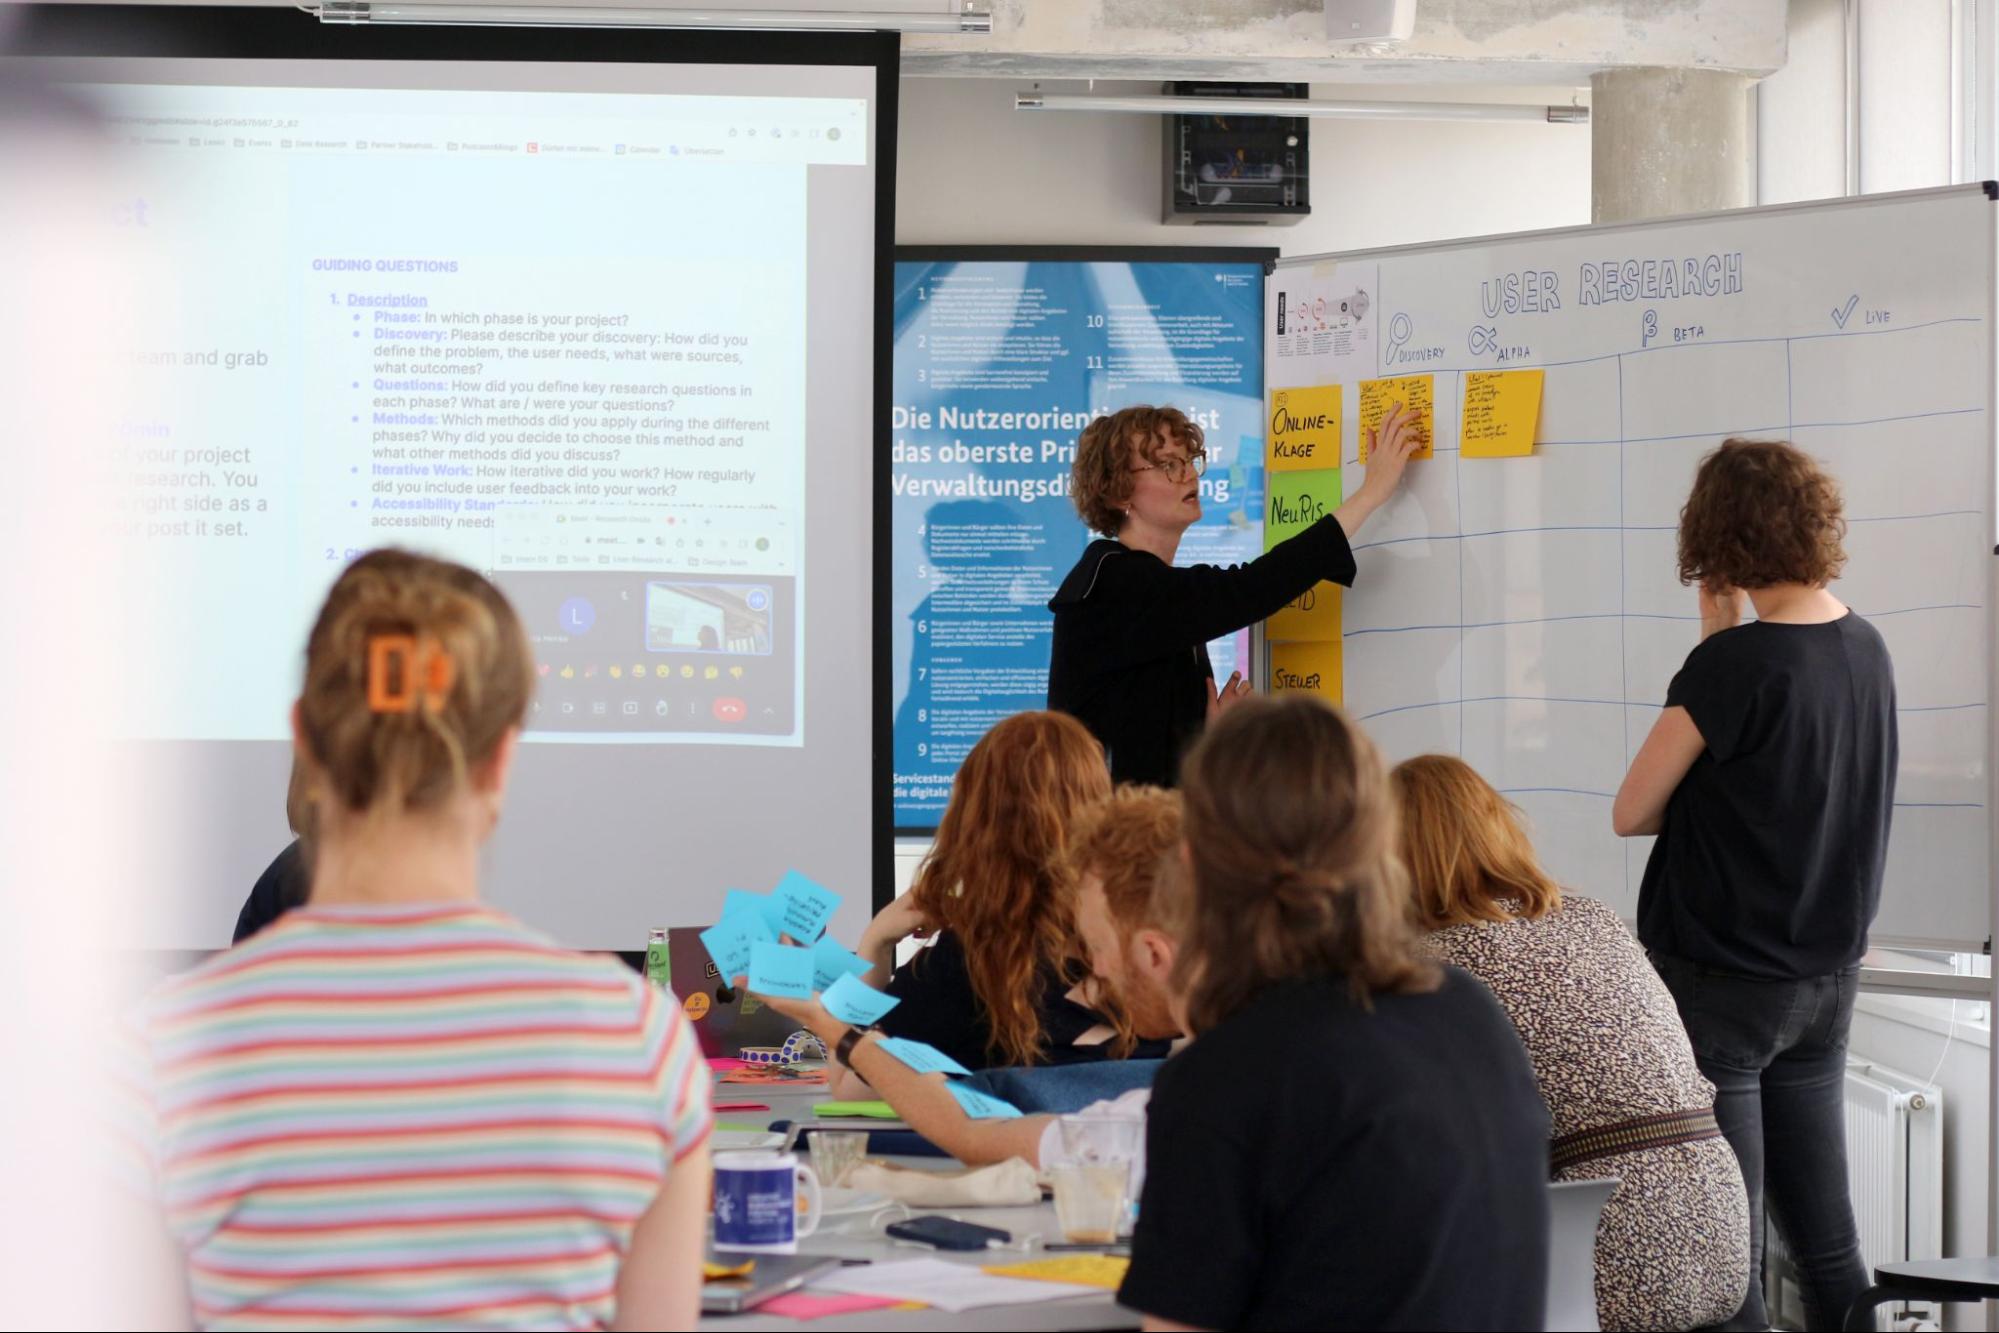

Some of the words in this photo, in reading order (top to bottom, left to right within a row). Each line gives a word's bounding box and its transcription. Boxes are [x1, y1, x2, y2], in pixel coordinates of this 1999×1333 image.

[312, 258, 372, 272] GUIDING
[376, 260, 459, 273] QUESTIONS
[1482, 270, 1560, 318] USER
[1578, 252, 1743, 306] RESEARCH
[330, 293, 340, 305] 1.
[347, 293, 428, 308] Description
[918, 288, 926, 300] 1
[374, 311, 421, 324] Phase:
[425, 312, 436, 324] In
[440, 312, 480, 324] which
[484, 312, 524, 327] phase
[527, 312, 538, 324] is
[542, 316, 572, 328] your
[575, 314, 630, 328] project?
[1087, 315, 1103, 328] 10
[374, 328, 448, 343] Discovery:
[451, 328, 494, 342] Please
[498, 329, 555, 342] describe
[560, 333, 589, 344] your
[593, 331, 662, 346] discovery:
[664, 333, 694, 345] How
[698, 332, 719, 345] did
[724, 337, 748, 348] you
[918, 336, 926, 348] 2
[1674, 326, 1705, 342] BETA
[129, 346, 177, 366] team
[182, 348, 218, 366] and
[224, 348, 268, 370] grab
[374, 345, 416, 356] define
[420, 346, 441, 357] the
[445, 346, 504, 360] problem,
[508, 347, 528, 358] the
[533, 350, 560, 358] user
[566, 348, 610, 362] needs,
[614, 350, 646, 361] what
[651, 352, 682, 362] were
[687, 353, 744, 364] sources,
[1087, 356, 1103, 368] 11
[1399, 347, 1446, 362] DISCOVERY
[1496, 346, 1531, 362] ALPHA
[374, 362, 406, 373] what
[410, 363, 484, 375] outcomes?
[918, 370, 926, 382] 3
[374, 379, 448, 392] Questions:
[452, 380, 481, 392] How
[485, 380, 506, 392] did
[510, 382, 534, 395] you
[538, 380, 578, 392] define
[583, 382, 605, 396] key
[610, 382, 668, 394] research
[672, 384, 736, 398] questions
[740, 384, 752, 396] in
[373, 396, 404, 408] each
[409, 396, 457, 410] phase?
[460, 397, 495, 408] What
[500, 400, 520, 408] are
[524, 398, 530, 410] /
[533, 400, 566, 410] were
[570, 402, 598, 412] your
[602, 400, 674, 414] questions?
[372, 412, 438, 424] Methods:
[441, 414, 482, 426] Which
[486, 414, 544, 426] methods
[548, 415, 568, 426] did
[573, 418, 596, 430] you
[601, 417, 636, 431] apply
[641, 418, 683, 432] during
[688, 418, 708, 430] the
[713, 418, 770, 432] different
[892, 406, 931, 430] Die
[1190, 407, 1219, 430] ist
[372, 430, 428, 444] phases?
[432, 432, 460, 445] Why
[464, 432, 485, 443] did
[490, 434, 513, 446] you
[517, 432, 561, 444] decide
[566, 434, 579, 444] to
[583, 433, 632, 444] choose
[636, 434, 660, 445] this
[664, 434, 715, 447] method
[718, 436, 744, 448] and
[136, 447, 177, 466] your
[184, 446, 250, 468] project
[372, 448, 404, 459] what
[410, 448, 444, 459] other
[449, 449, 506, 460] methods
[511, 448, 532, 460] did
[536, 452, 559, 463] you
[564, 448, 621, 461] discuss?
[892, 440, 931, 463] das
[939, 440, 1033, 463] oberste
[1274, 440, 1315, 458] KLAGE
[223, 471, 258, 487] You
[372, 464, 429, 475] Iterative
[433, 465, 472, 476] Work:
[476, 466, 506, 476] How
[510, 465, 563, 477] iterative
[568, 466, 588, 478] did
[592, 468, 616, 480] you
[620, 467, 660, 478] work?
[664, 468, 694, 480] How
[698, 469, 756, 484] regularly
[372, 481, 393, 493] did
[397, 484, 421, 496] you
[425, 482, 473, 494] include
[477, 485, 505, 494] user
[509, 482, 570, 494] feedback
[575, 483, 600, 495] into
[604, 486, 633, 498] your
[637, 484, 677, 496] work?
[184, 495, 222, 512] side
[229, 498, 250, 512] as
[256, 498, 268, 512] a
[372, 498, 460, 513] Accessibility
[148, 521, 190, 540] post
[196, 520, 208, 536] it
[214, 521, 248, 536] set.
[371, 515, 453, 529] accessibility
[918, 525, 926, 536] 4
[918, 566, 926, 578] 5
[572, 608, 584, 624] L
[918, 621, 926, 633] 6
[918, 668, 926, 680] 7
[1276, 668, 1320, 689] STEUER
[918, 710, 926, 722] 8
[918, 744, 926, 756] 9
[894, 772, 956, 784] Servicestand
[910, 787, 948, 800] digitale
